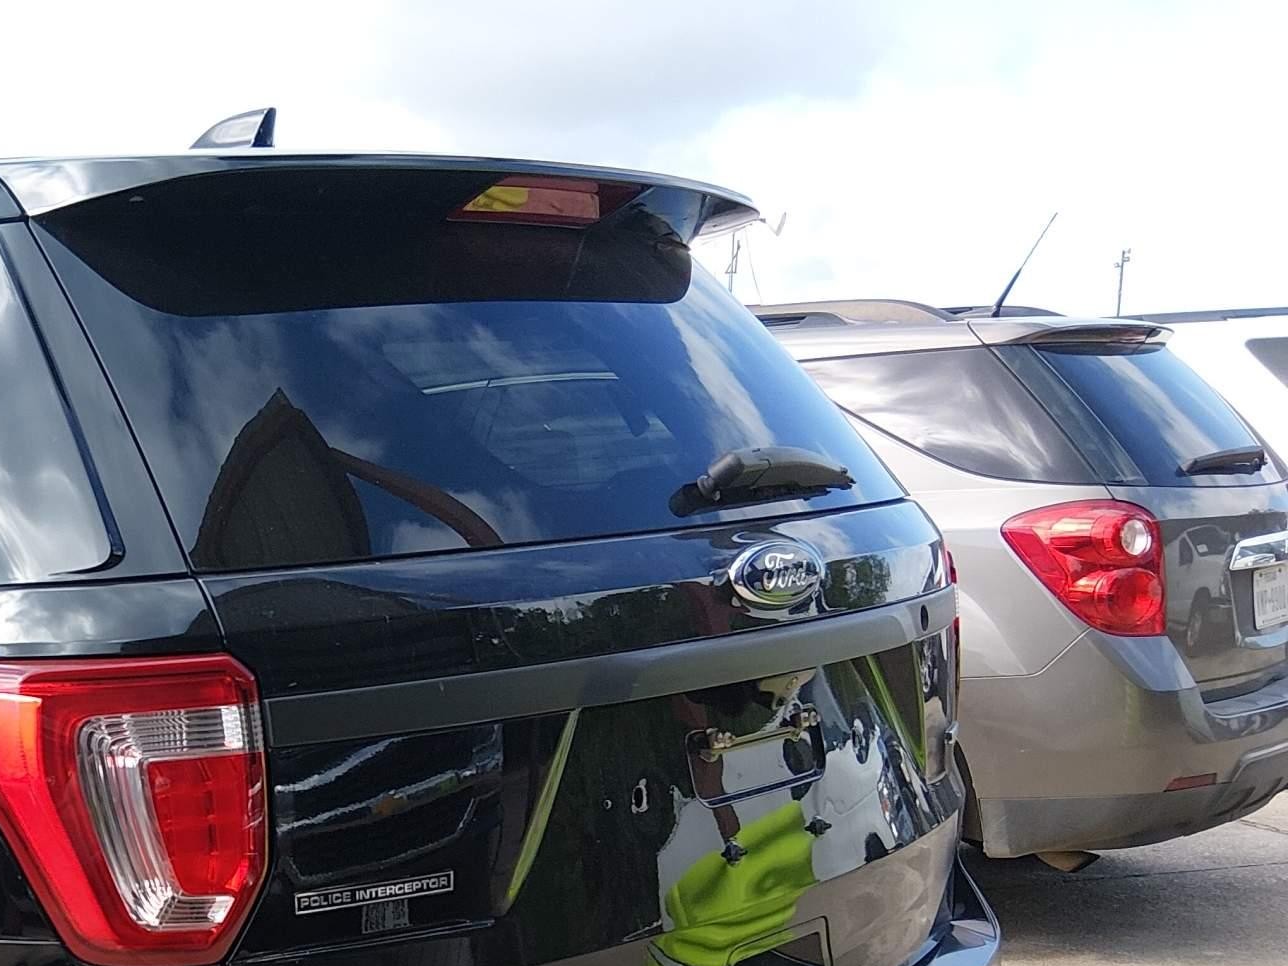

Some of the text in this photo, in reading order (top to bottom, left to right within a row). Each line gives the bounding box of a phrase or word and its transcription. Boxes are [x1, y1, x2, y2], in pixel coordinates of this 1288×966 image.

[762, 552, 811, 591] Ford
[300, 876, 449, 909] POLICE INTERCEPTOR
